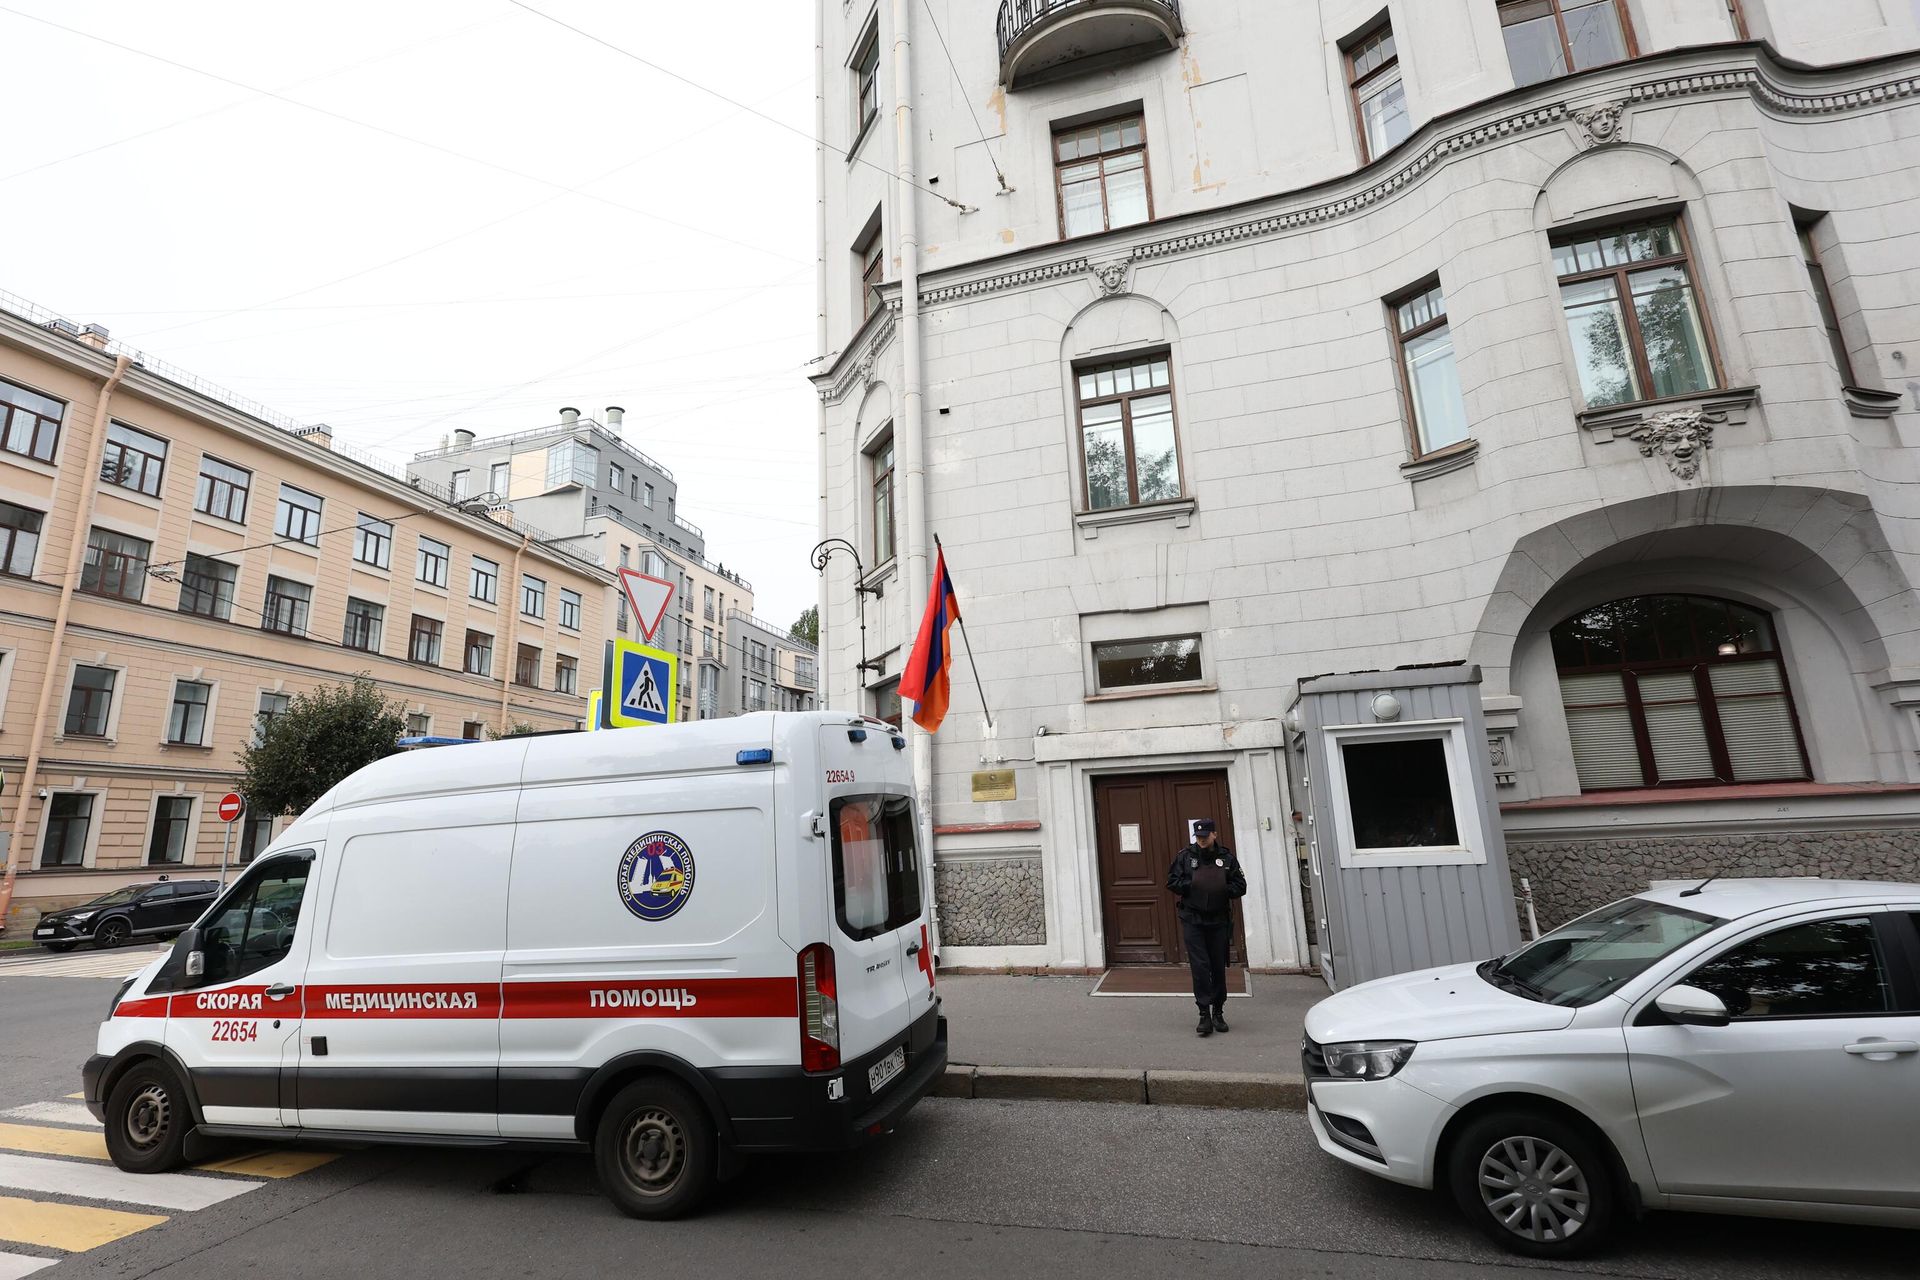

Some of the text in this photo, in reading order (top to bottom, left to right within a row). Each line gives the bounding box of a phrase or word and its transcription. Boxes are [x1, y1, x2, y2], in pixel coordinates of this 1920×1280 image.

[647, 841, 665, 856] 03
[621, 835, 692, 901] СКОРАЯ МЕДИЦИНСКАЯ ПОМОЩЬ
[196, 988, 697, 1013] СКОРАЯ МЕДИЦИНСКАЯ ПОМОЩЬ
[211, 1020, 258, 1042] 22654
